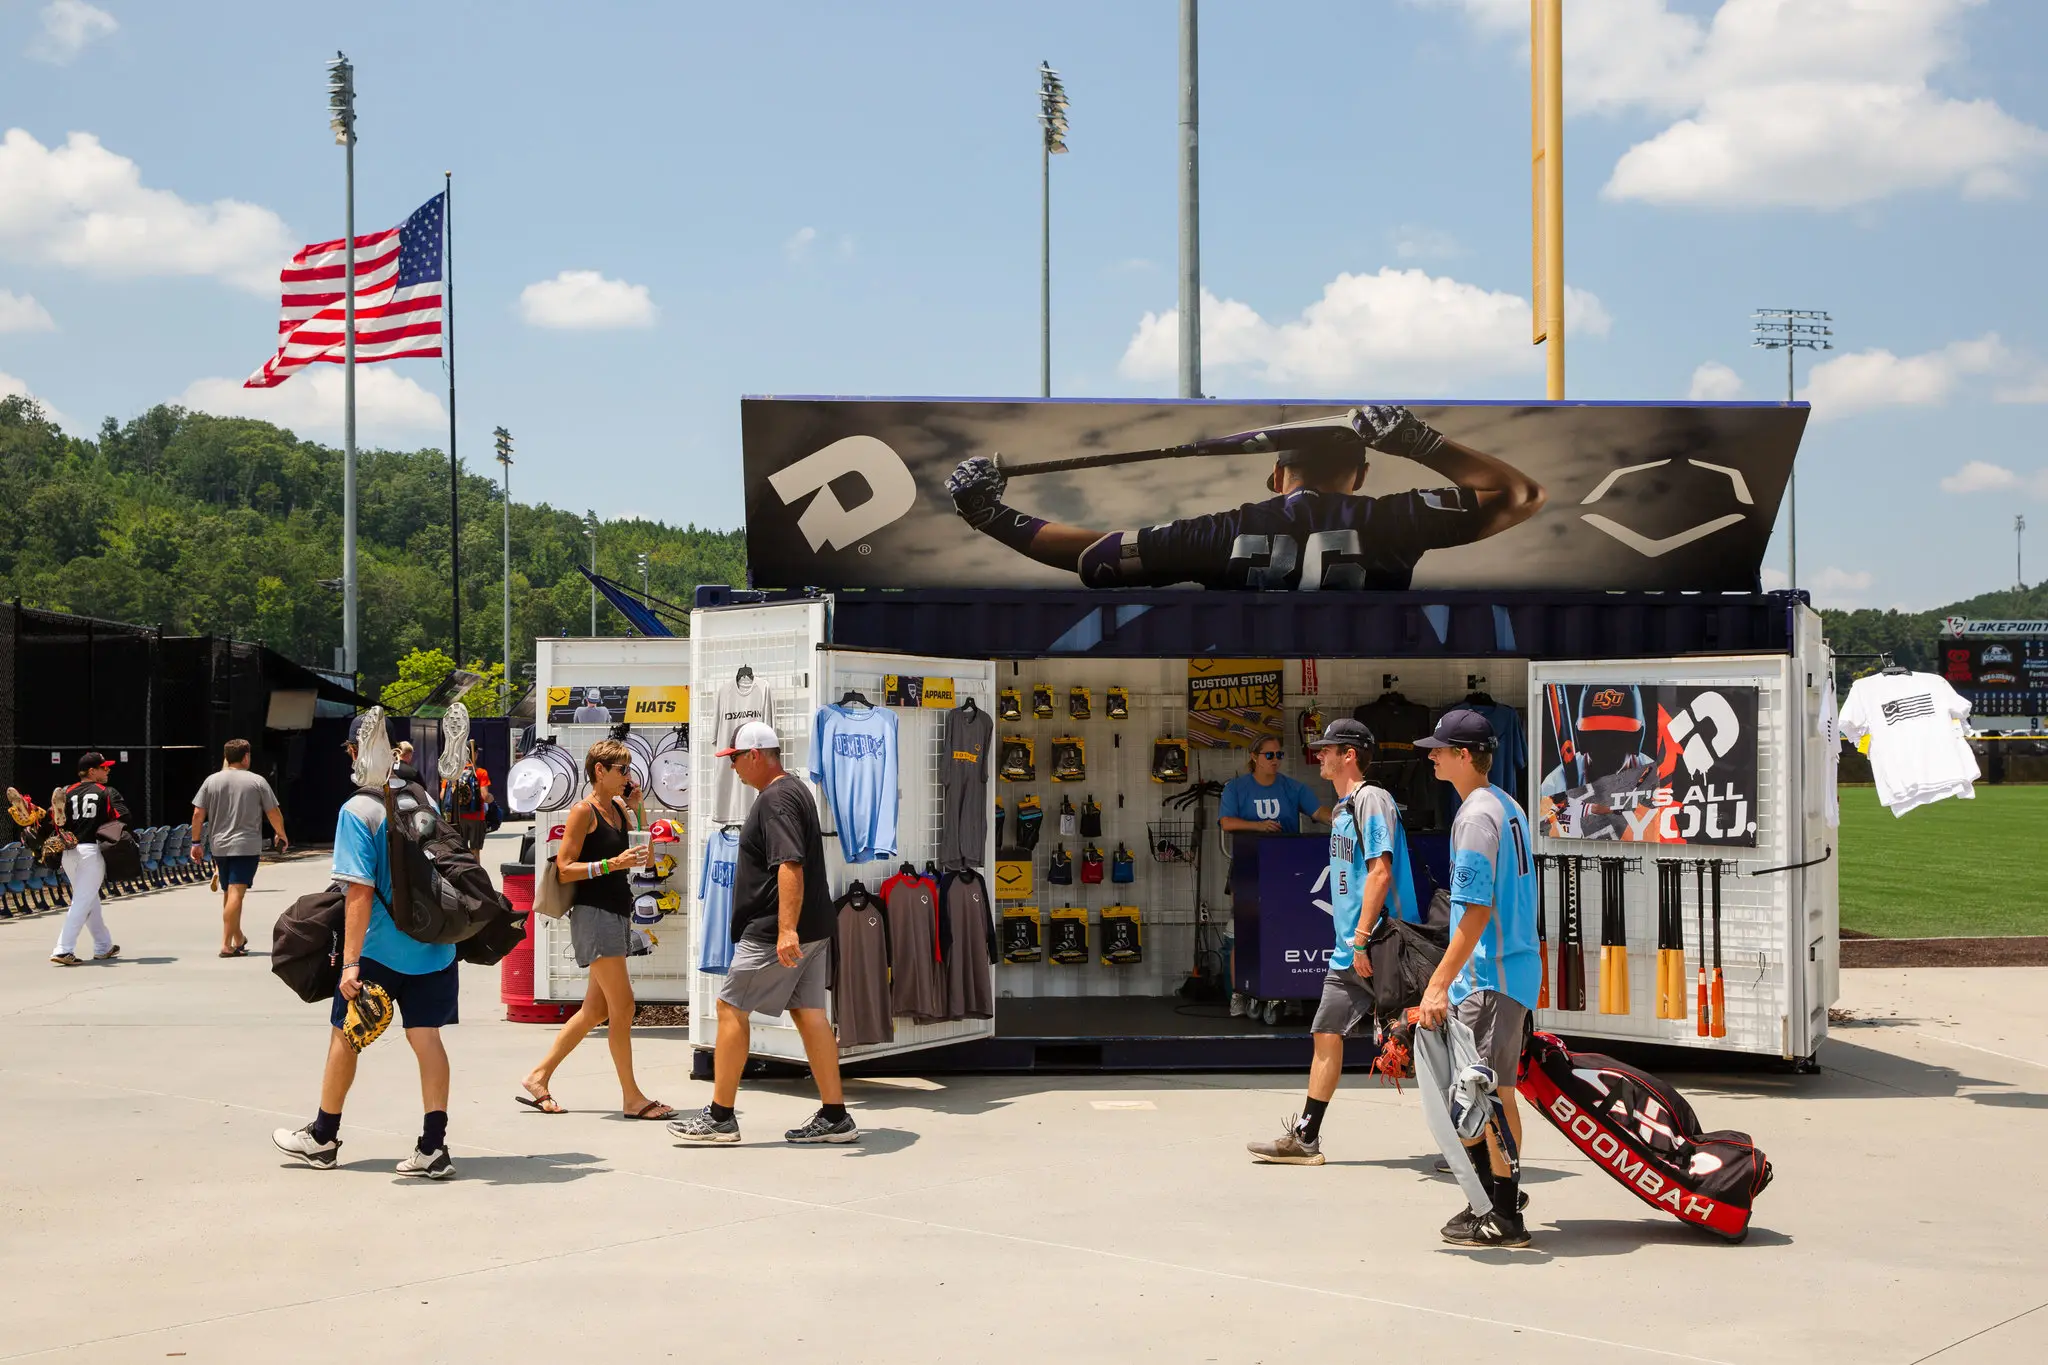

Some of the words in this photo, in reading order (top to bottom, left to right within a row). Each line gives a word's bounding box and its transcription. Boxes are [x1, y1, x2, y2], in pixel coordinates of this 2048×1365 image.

[1192, 677, 1239, 690] CUSTOM
[1241, 674, 1277, 685] STRAP
[924, 689, 953, 700] APPAREL
[1193, 685, 1265, 711] ZONE
[1592, 689, 1625, 709] OSU
[635, 701, 677, 713] HATS
[71, 793, 99, 820] 16
[1610, 788, 1674, 811] IT'S
[1682, 782, 1743, 804] ALL
[1339, 871, 1349, 894] 5
[1550, 1095, 1715, 1221] BOOMBAH
